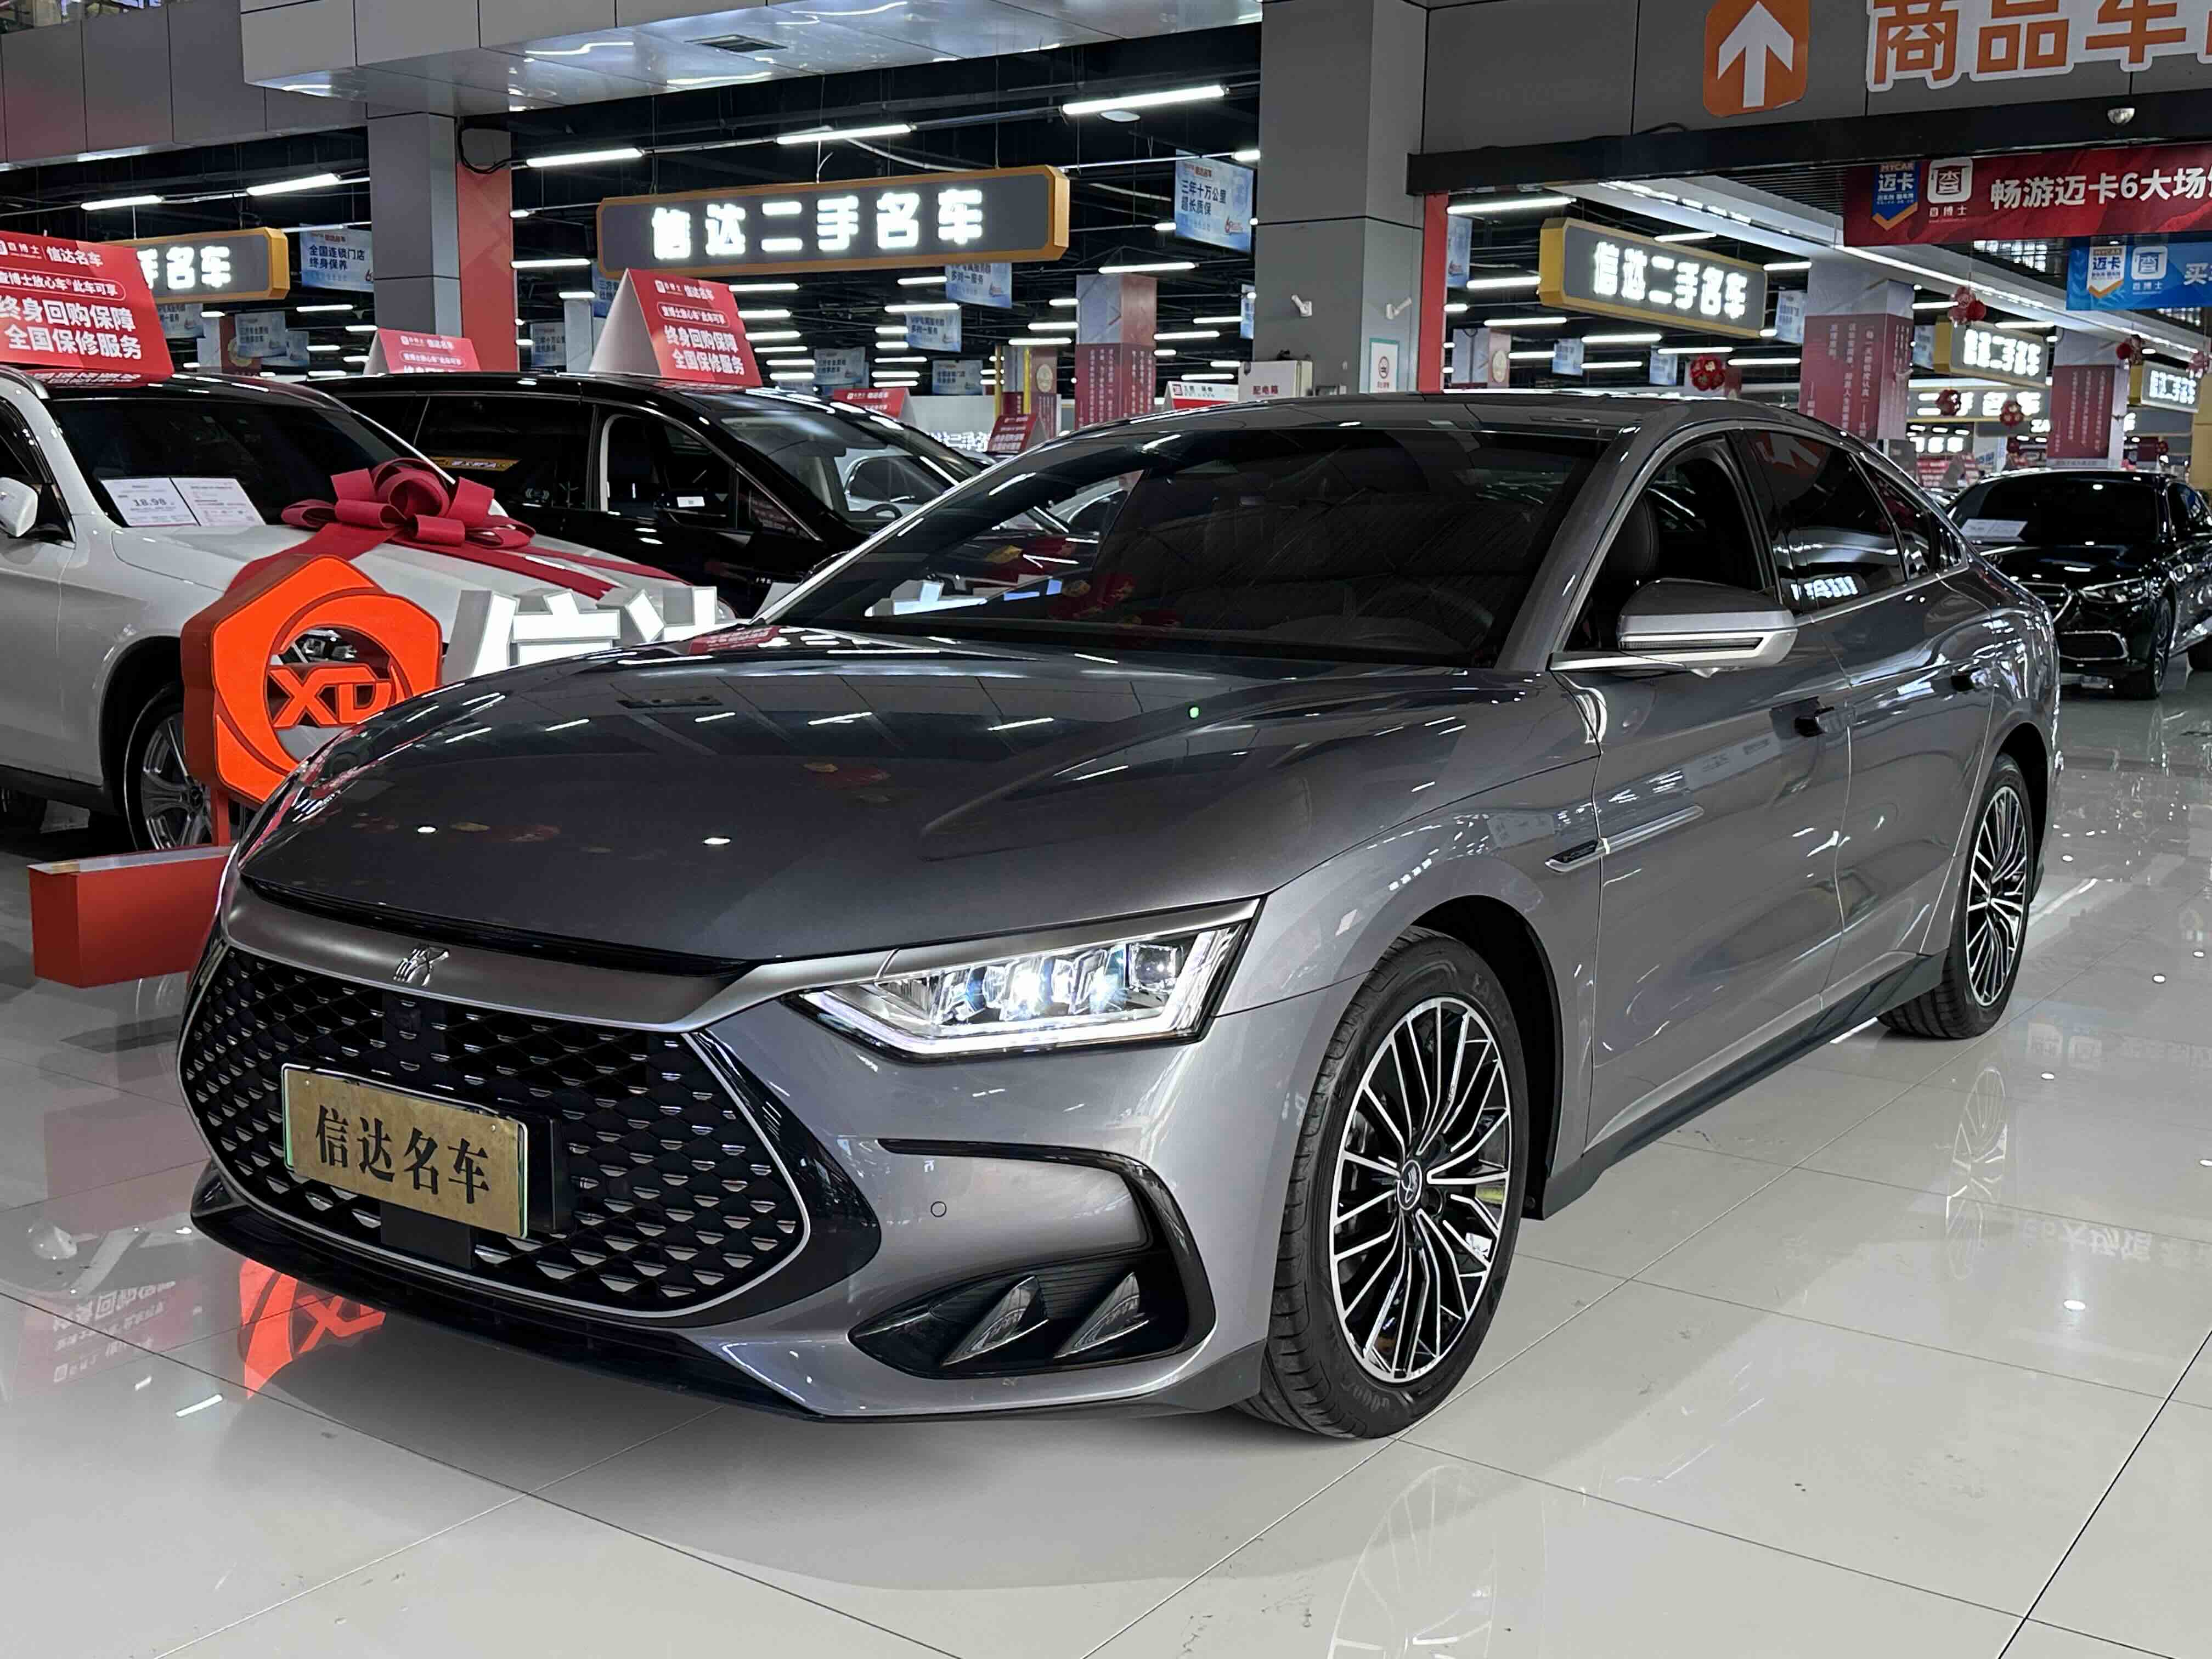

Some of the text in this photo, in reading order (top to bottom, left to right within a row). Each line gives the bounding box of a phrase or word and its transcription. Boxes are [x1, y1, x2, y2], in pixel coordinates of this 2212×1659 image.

[1872, 0, 2212, 84] 商品车
[1181, 179, 1227, 204] 三年十万公里
[1878, 172, 1914, 192] 迈卡
[1990, 167, 2212, 211] 畅游迈卡6大场
[651, 188, 983, 259] 信达二手名车
[46, 245, 104, 267] 信达名车
[308, 244, 365, 261] 全国连锁门店
[2092, 257, 2121, 270] 迈卡
[1593, 240, 1748, 320] 信达二手名车
[2183, 263, 2212, 286] 买
[0, 295, 136, 332] 终身回购保障
[4, 324, 142, 360] 全国保修服务
[664, 325, 738, 353] 终身回购保障
[672, 348, 744, 375] 全国保修服务
[315, 1104, 490, 1204] 信达名车
